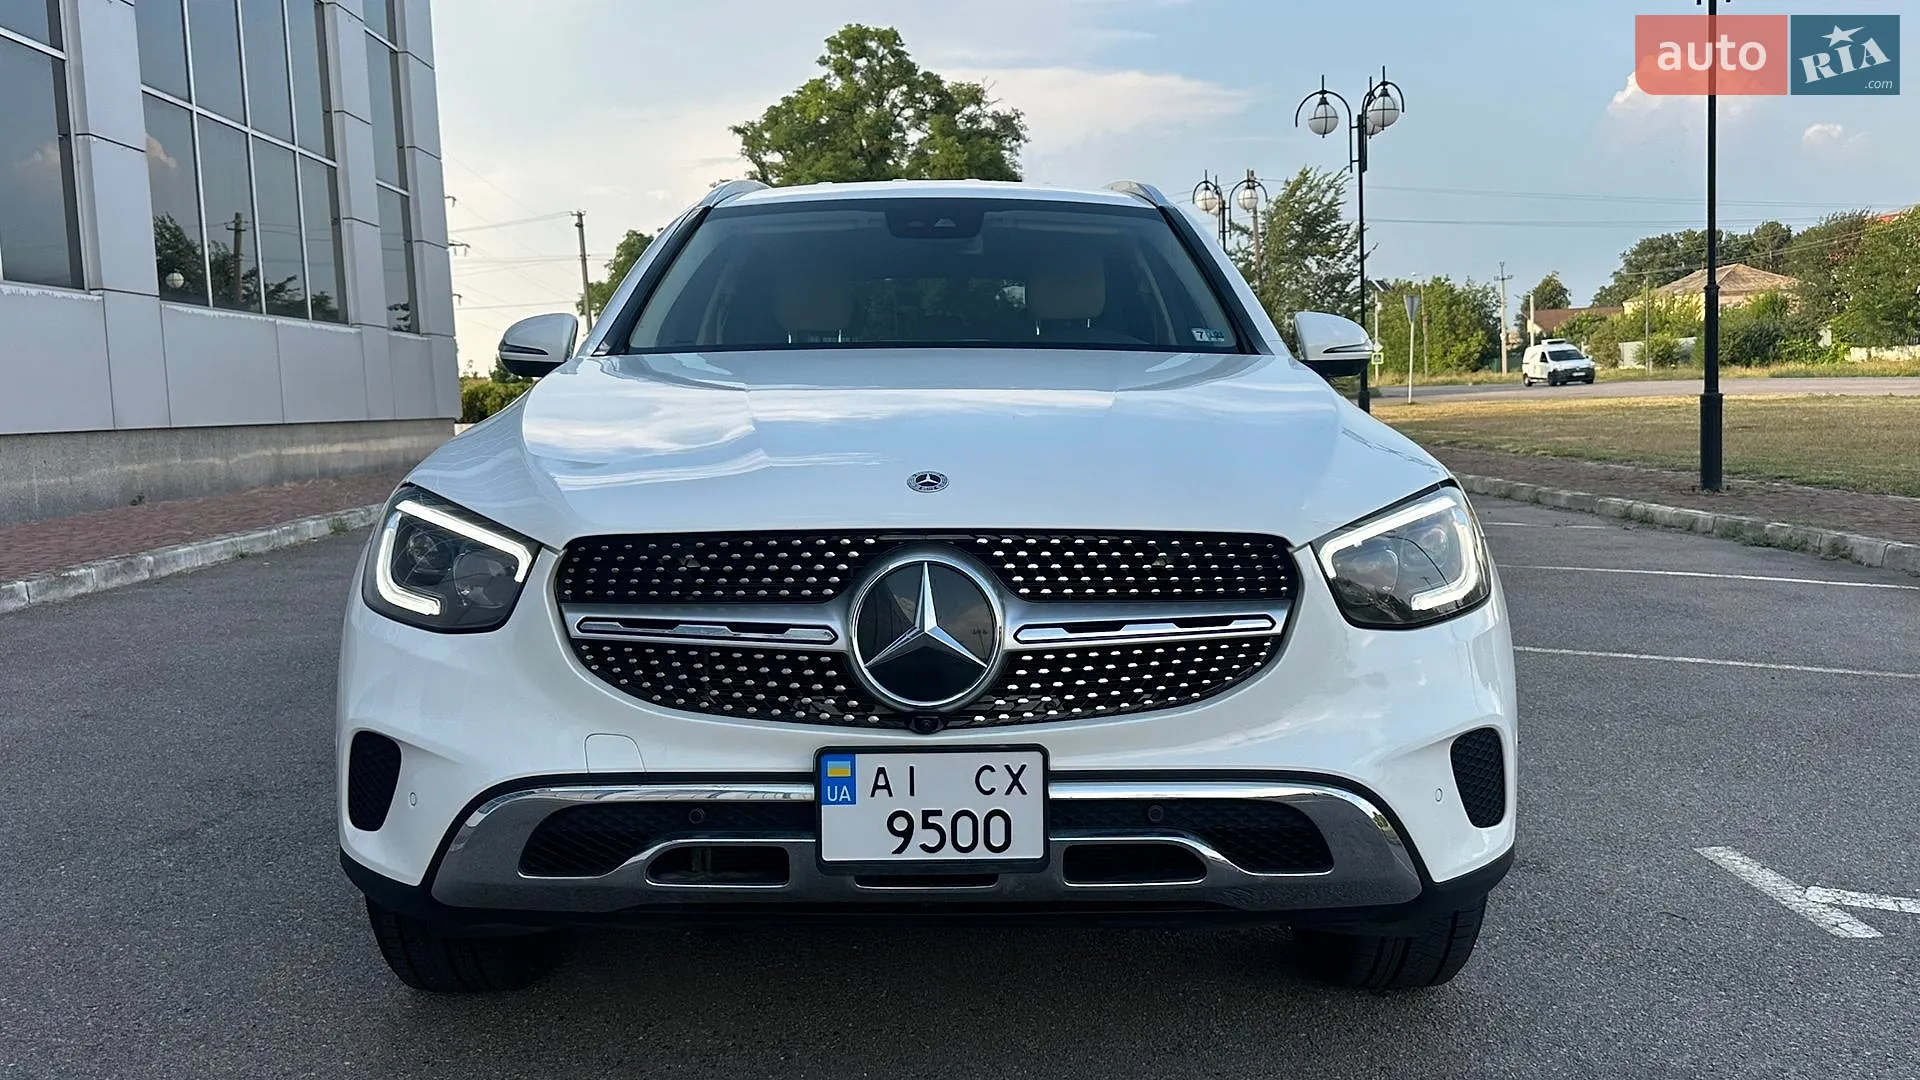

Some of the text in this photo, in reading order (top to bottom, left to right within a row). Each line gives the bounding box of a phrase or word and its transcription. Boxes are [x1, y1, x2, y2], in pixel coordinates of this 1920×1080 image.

[827, 785, 851, 802] UA
[870, 764, 1028, 797] AI CX
[886, 809, 1012, 854] 9500
